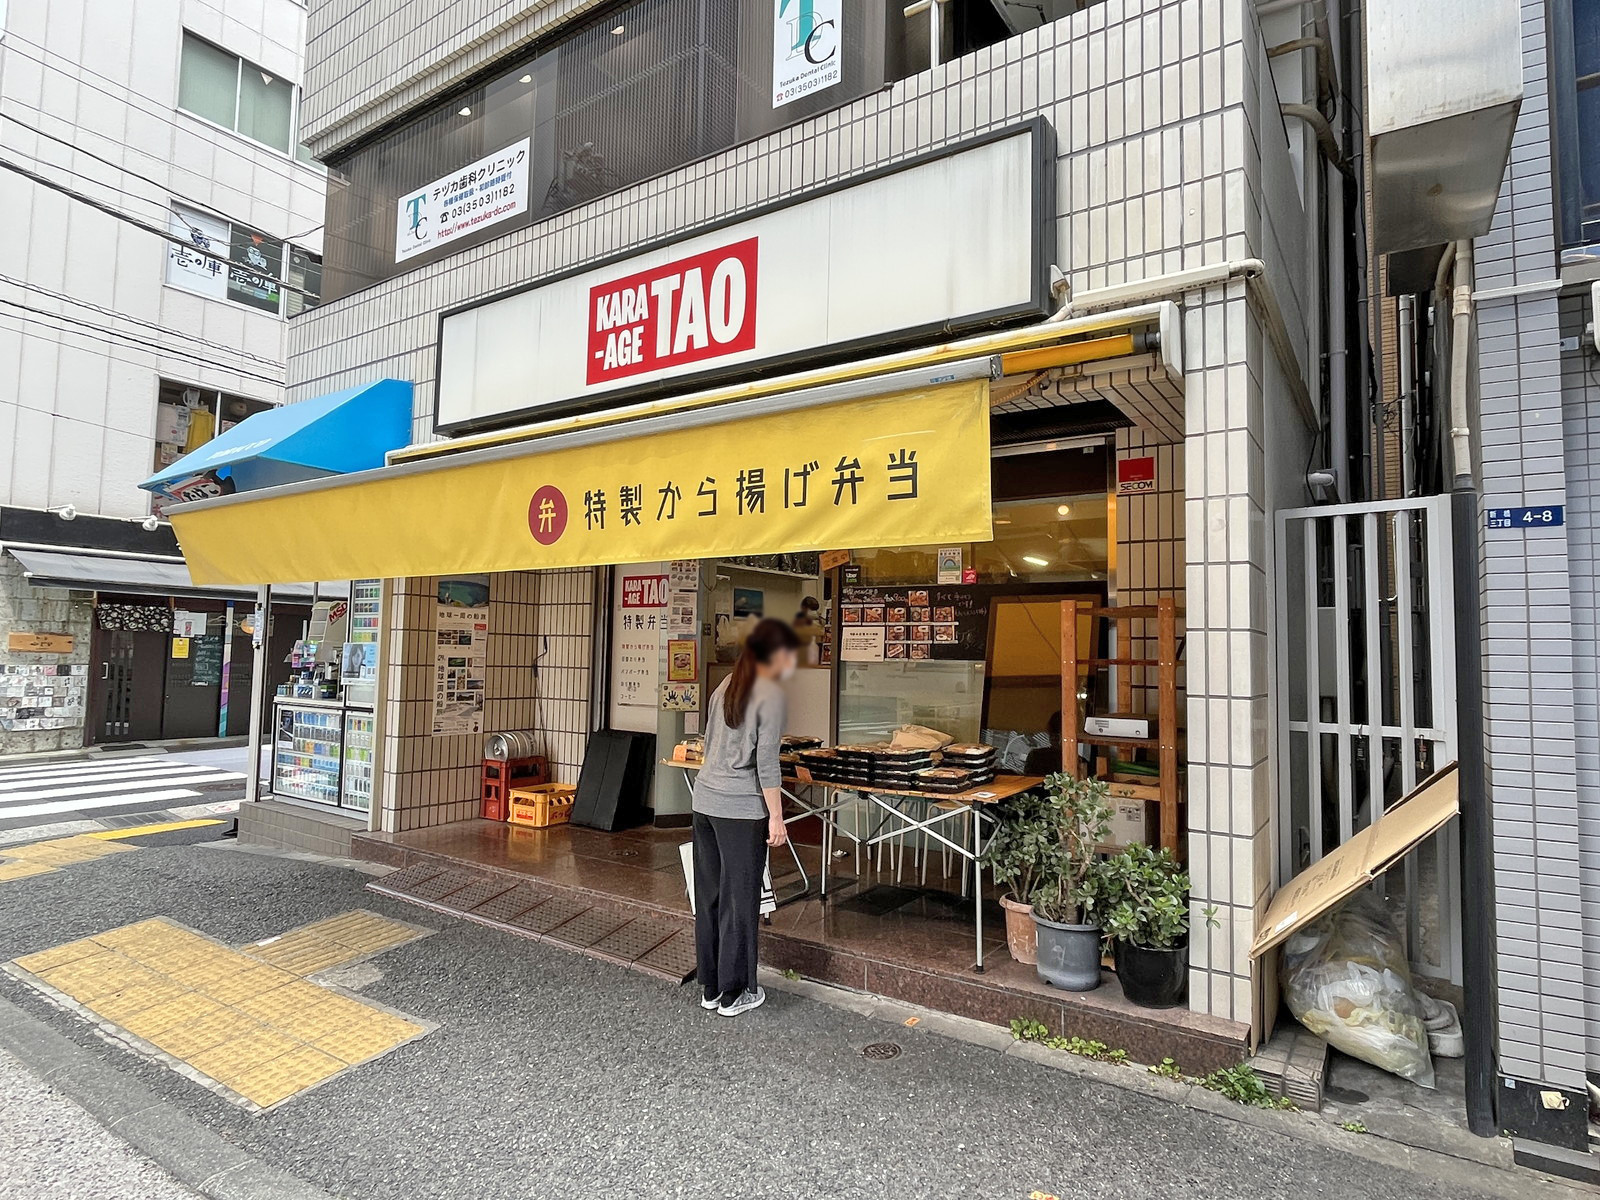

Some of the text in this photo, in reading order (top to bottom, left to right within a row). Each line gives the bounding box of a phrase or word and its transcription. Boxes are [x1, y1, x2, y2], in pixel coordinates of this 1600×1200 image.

[785, 69, 838, 99] 03(3503)1182
[451, 183, 515, 219] 03(3503)1182
[596, 283, 649, 333] KARA
[651, 256, 747, 359] TAO
[594, 325, 645, 371] -AGE
[583, 448, 920, 531] 特製から揚げ弁当
[1120, 481, 1153, 490] SECOM
[537, 497, 557, 534] 弁
[1522, 510, 1553, 522] 4-8
[641, 578, 669, 605] TAO
[623, 614, 668, 630] 特製弁当
